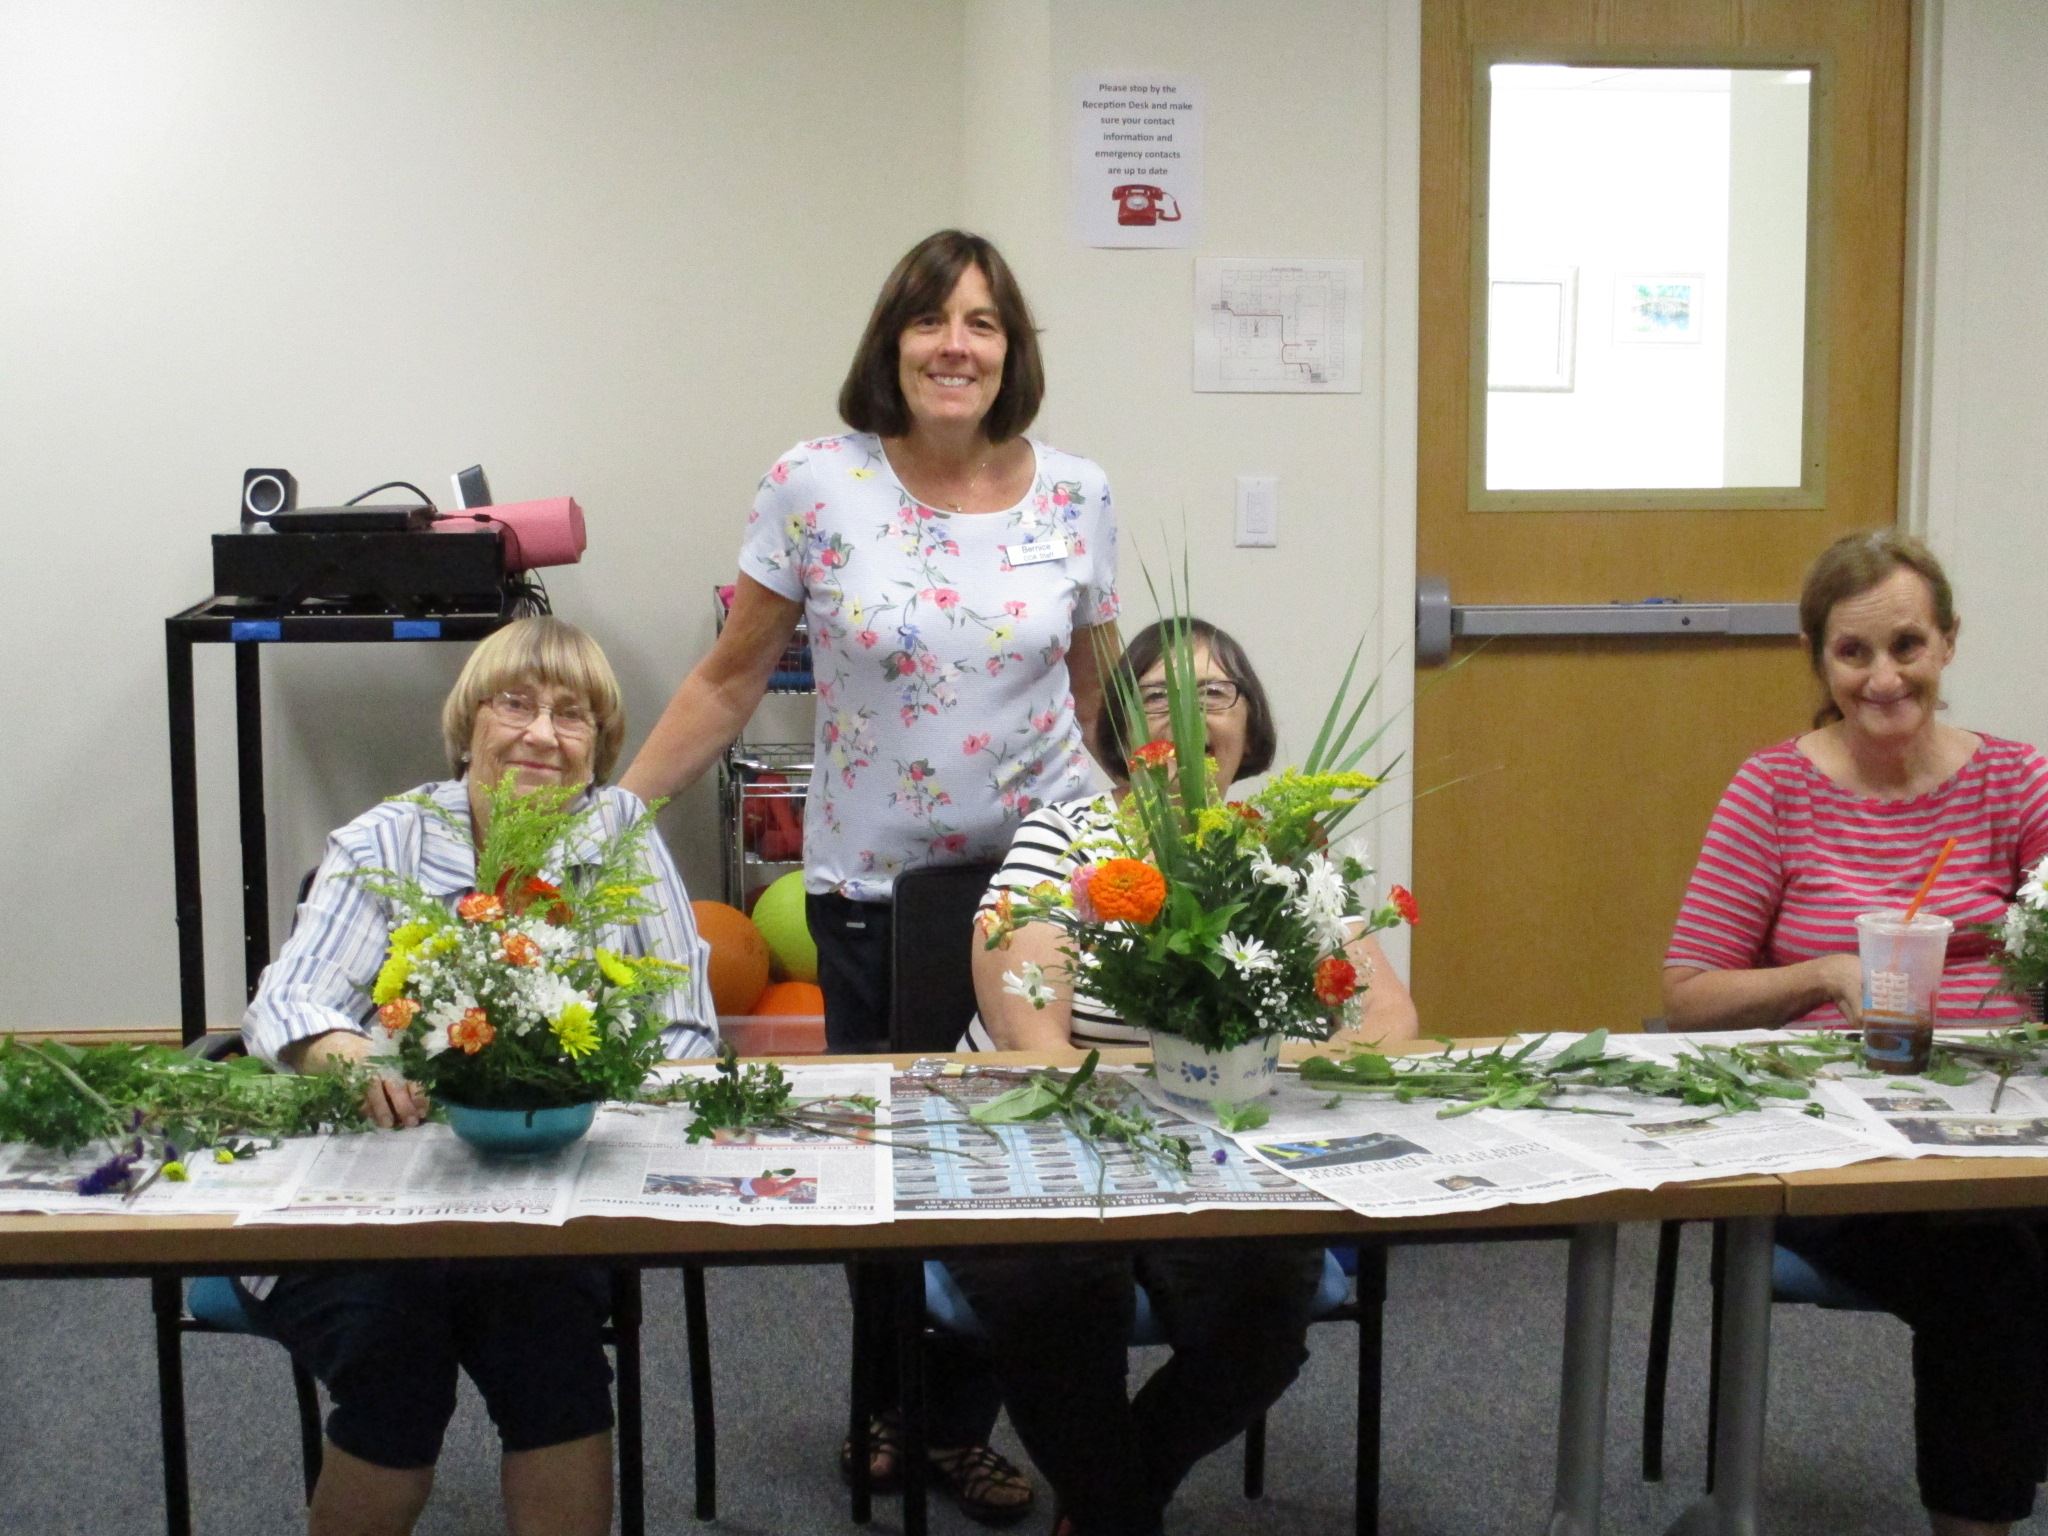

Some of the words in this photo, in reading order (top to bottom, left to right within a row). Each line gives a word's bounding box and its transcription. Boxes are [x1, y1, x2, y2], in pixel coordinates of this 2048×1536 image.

[1099, 84, 1127, 94] Please
[1130, 84, 1147, 95] stop
[1150, 84, 1160, 95] by
[1162, 85, 1176, 94] the
[1082, 101, 1126, 112] Reception
[1129, 101, 1149, 110] Desk
[1151, 102, 1167, 111] and
[1170, 102, 1193, 111] make
[1101, 117, 1119, 125] sure
[1122, 117, 1141, 127] your
[1143, 117, 1175, 126] contact
[1103, 132, 1154, 142] information
[1157, 133, 1173, 142] and
[1095, 150, 1143, 160] emergency
[1145, 150, 1180, 159] contacts
[1108, 167, 1121, 175] are
[1124, 167, 1135, 177] up
[1138, 166, 1146, 175] to
[1149, 166, 1168, 175] date
[1022, 544, 1051, 553] Bernice
[356, 1206, 549, 1217] CLASSIFIEDS
